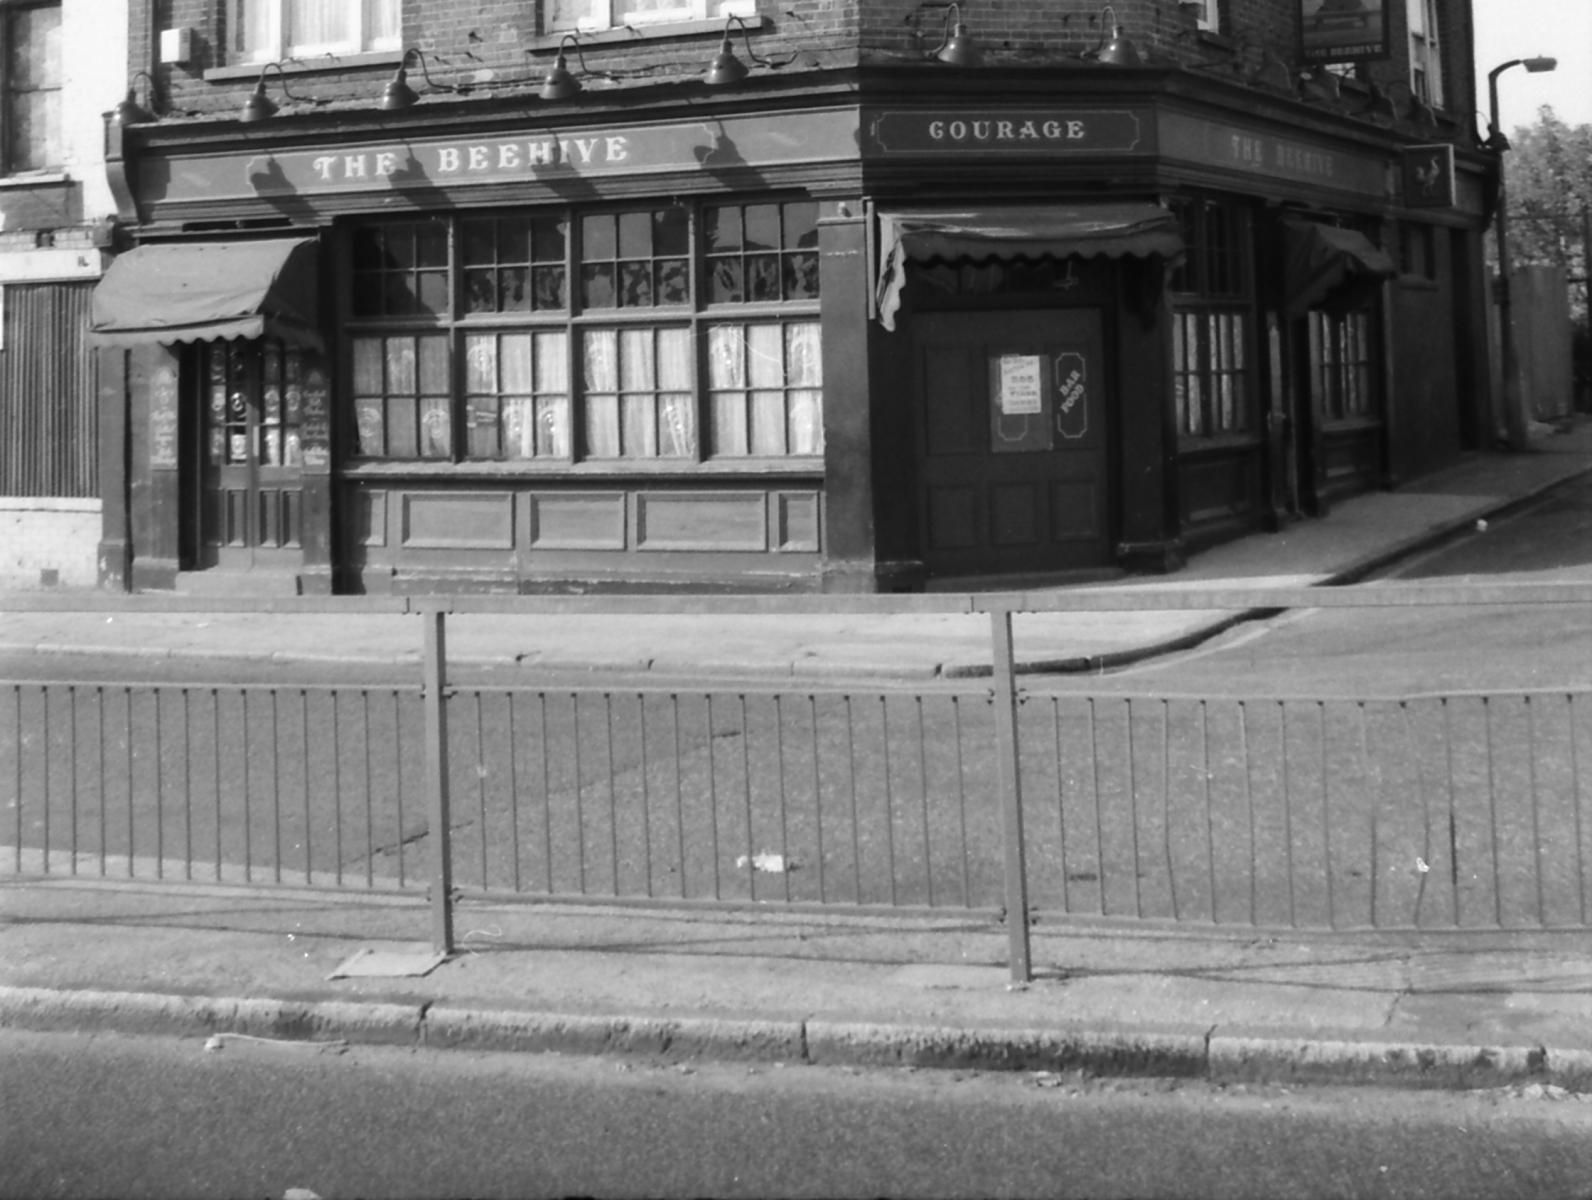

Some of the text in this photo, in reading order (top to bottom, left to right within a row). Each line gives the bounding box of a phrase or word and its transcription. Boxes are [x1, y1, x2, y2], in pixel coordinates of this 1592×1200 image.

[929, 121, 1085, 139] COURAGE
[313, 136, 628, 179] THE BEEHIVE
[1231, 134, 1262, 162] THE
[1059, 369, 1081, 396] BAR
[1060, 384, 1084, 414] FOOD
